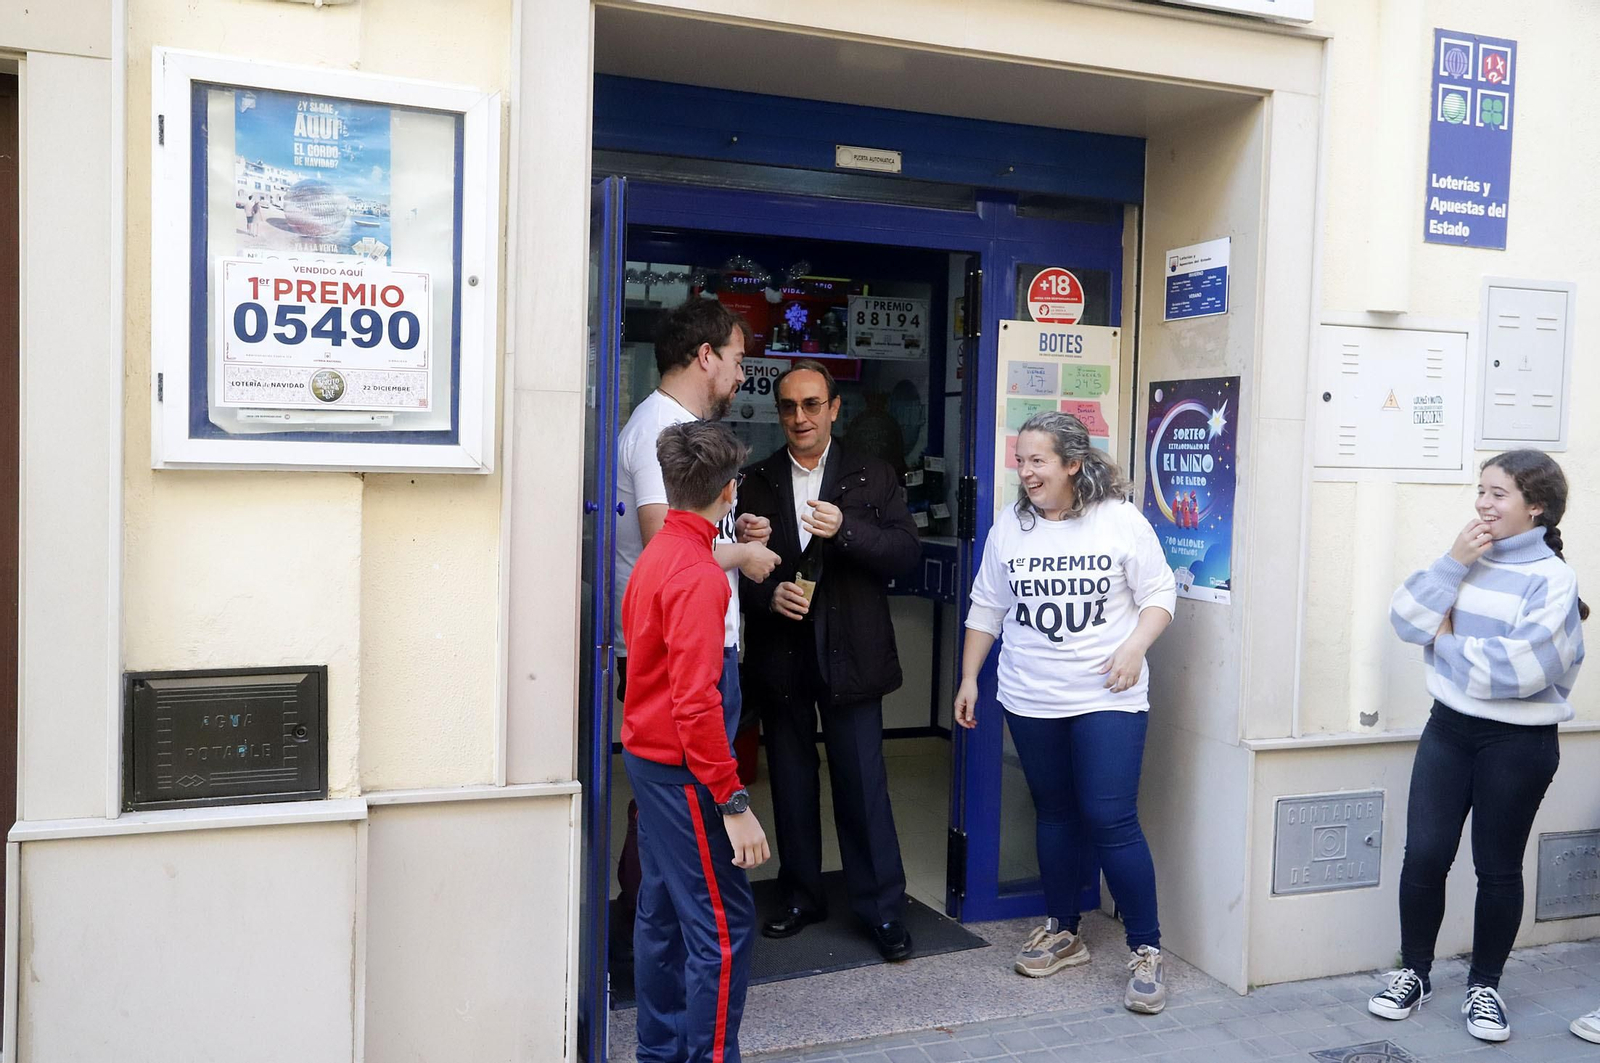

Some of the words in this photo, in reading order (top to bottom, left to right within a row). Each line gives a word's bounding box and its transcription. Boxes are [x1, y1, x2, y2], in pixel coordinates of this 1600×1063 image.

[319, 103, 334, 114] CAE
[294, 111, 339, 140] AQUÍ
[294, 143, 305, 156] EL
[307, 144, 339, 159] GORDO
[294, 156, 303, 166] DE
[304, 157, 339, 169] NAVIDAD?
[1432, 173, 1480, 193] Loterías
[1482, 181, 1491, 198] y
[1430, 196, 1484, 216] Apuestas
[1487, 202, 1506, 218] del
[1429, 219, 1470, 237] Estado
[319, 243, 338, 253] VENTA
[293, 266, 337, 276] VENDIDO
[340, 268, 363, 277] AQUÍ
[274, 278, 405, 308] PREMIO
[1039, 275, 1071, 295] +18
[873, 300, 913, 312] PREMIO
[233, 302, 420, 350] 05490
[856, 311, 921, 329] 88194
[1039, 332, 1083, 354] BOTES
[1173, 428, 1206, 440] SORTEO
[1163, 453, 1177, 471] EL
[1180, 453, 1214, 473] NIÑO
[1170, 476, 1175, 484] 6
[1176, 476, 1184, 485] DE
[1185, 477, 1207, 486] ENERO
[1165, 536, 1176, 545] 700
[1177, 538, 1204, 548] MILLONES
[1007, 558, 1026, 573] 1er
[1028, 555, 1112, 573] PREMIO
[1008, 577, 1111, 597] VENDIDO
[1015, 595, 1108, 643] AQUÍ
[201, 714, 253, 728] AGUA
[1287, 801, 1374, 825] CONTADOR
[1290, 866, 1310, 885] DE
[1325, 861, 1365, 881] AGUA
